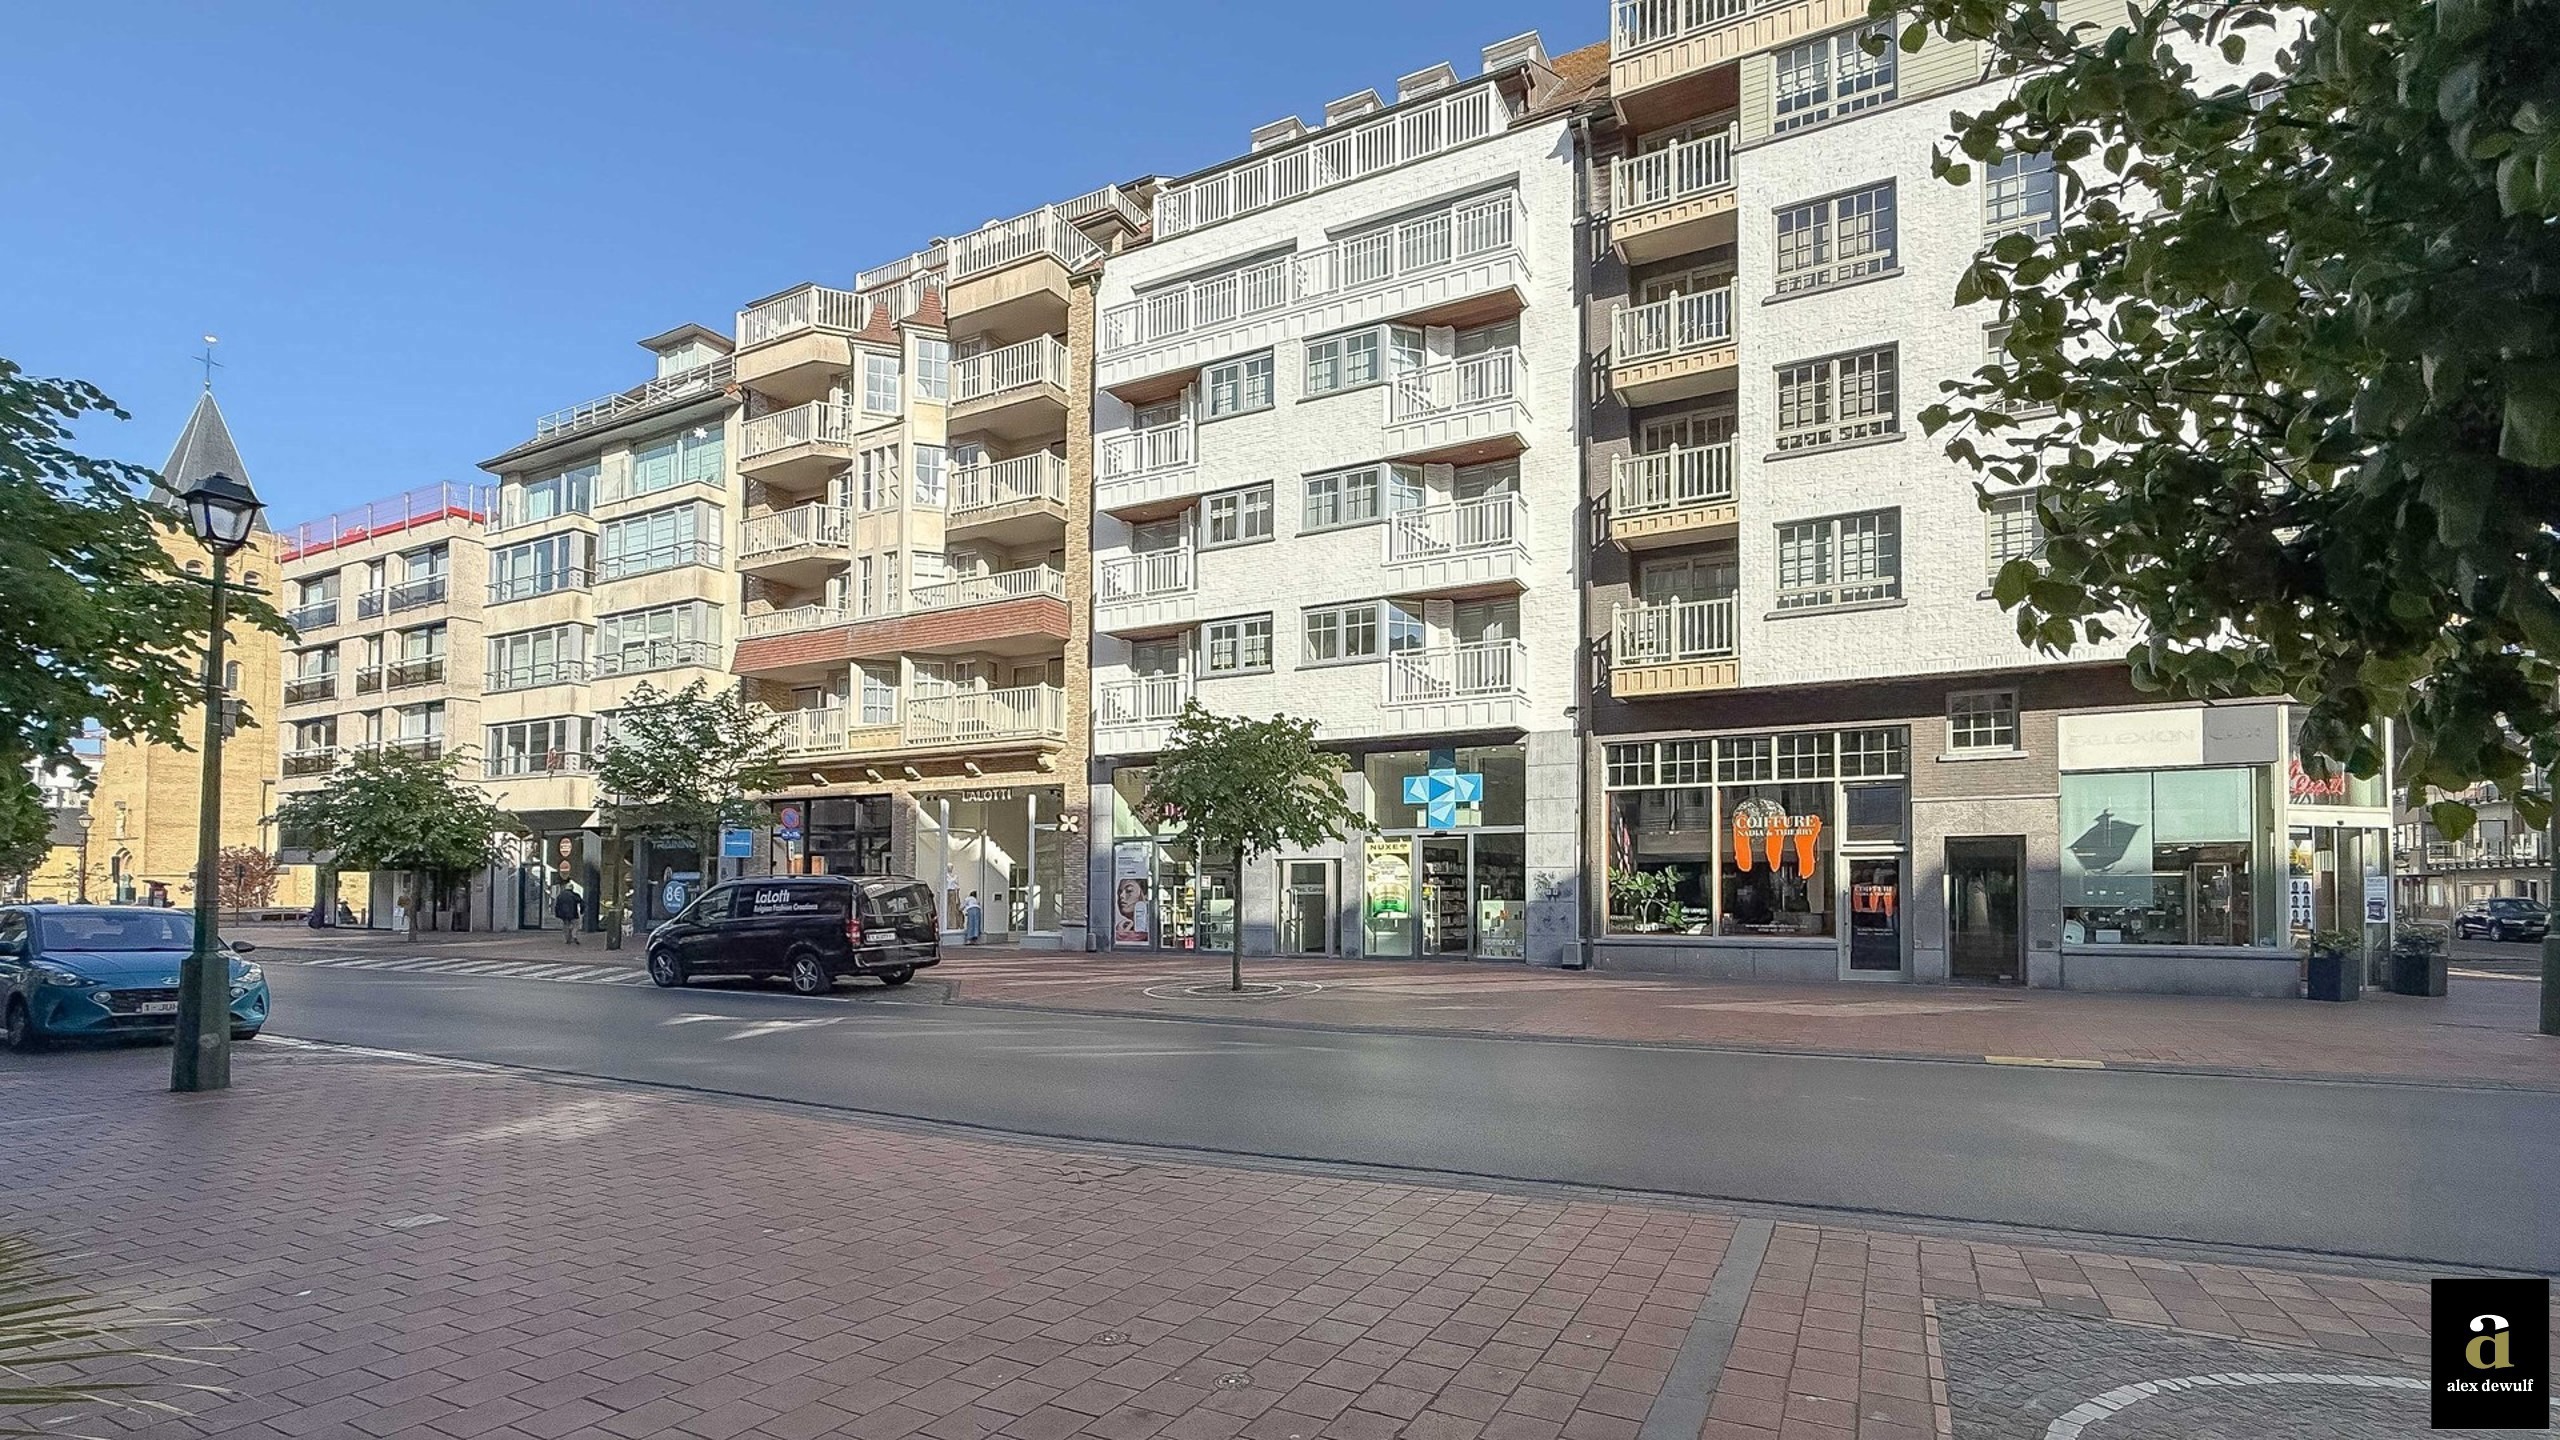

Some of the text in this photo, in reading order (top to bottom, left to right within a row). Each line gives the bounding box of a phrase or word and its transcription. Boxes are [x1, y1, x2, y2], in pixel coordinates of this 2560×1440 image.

[1736, 815, 1816, 829] COIFFURE
[1737, 828, 1765, 837] NADIA
[1774, 828, 1814, 836] THIERRY
